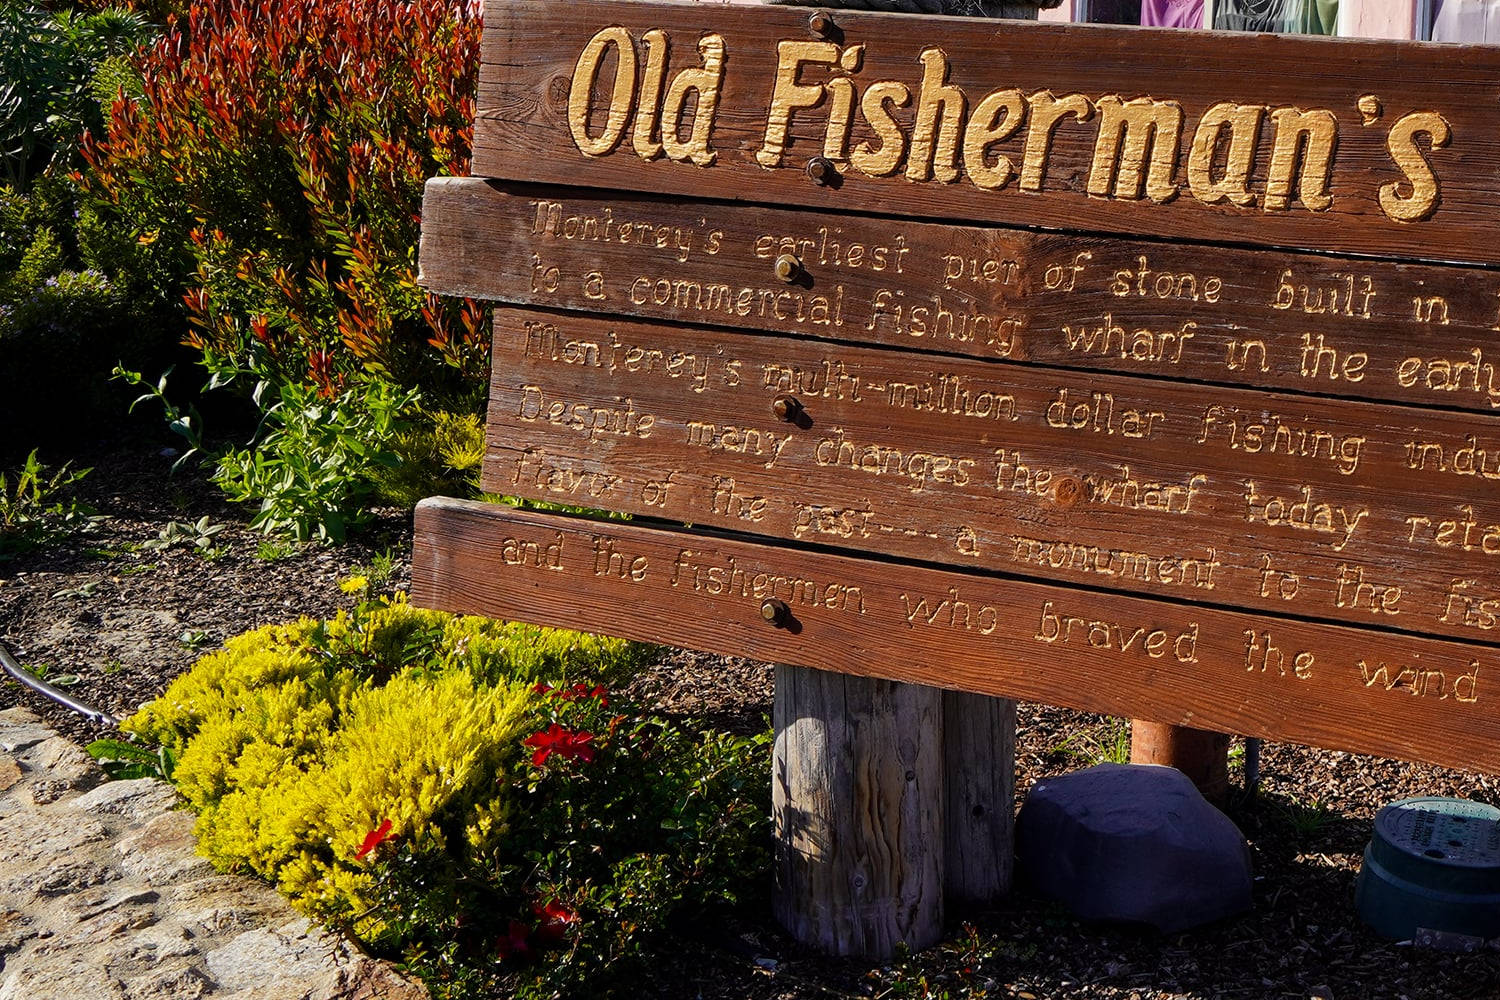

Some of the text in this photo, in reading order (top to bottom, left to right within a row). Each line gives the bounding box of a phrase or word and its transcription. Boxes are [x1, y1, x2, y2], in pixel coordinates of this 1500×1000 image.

[566, 25, 728, 168] Old
[756, 39, 1453, 223] Fisherman's
[529, 200, 724, 262] Monterey's
[754, 225, 909, 273] earliest
[941, 252, 1021, 290] pier
[1044, 251, 1093, 292] of
[1111, 255, 1222, 303] stone
[1270, 268, 1376, 319] built
[1412, 279, 1449, 325] in
[530, 251, 561, 294] to
[583, 270, 607, 301] a
[629, 275, 844, 327] commercial
[865, 288, 1022, 357] fishing
[1062, 311, 1198, 364] wharf
[1225, 325, 1270, 373] in
[1300, 332, 1368, 382] the
[516, 383, 656, 445] Despite
[686, 419, 793, 470] many
[814, 425, 976, 493] changes
[994, 448, 1053, 498] the
[1083, 463, 1209, 515] wharf
[1242, 477, 1370, 552] today
[524, 320, 743, 394] Monterey's
[761, 357, 1020, 422] multi-million
[1046, 387, 1166, 438] dollar
[1197, 404, 1368, 476] fishing
[509, 448, 624, 499] flavor
[640, 470, 681, 509] of
[709, 474, 769, 523] the
[954, 524, 980, 558] a
[1009, 534, 1222, 591] monument
[1259, 552, 1300, 600] to
[1335, 561, 1402, 615] the
[501, 530, 565, 571] and
[591, 534, 650, 583] the
[669, 548, 867, 615] fishermen
[899, 585, 998, 636] who
[1034, 599, 1200, 664] braved
[1243, 629, 1315, 680] the
[1358, 653, 1481, 703] wind
